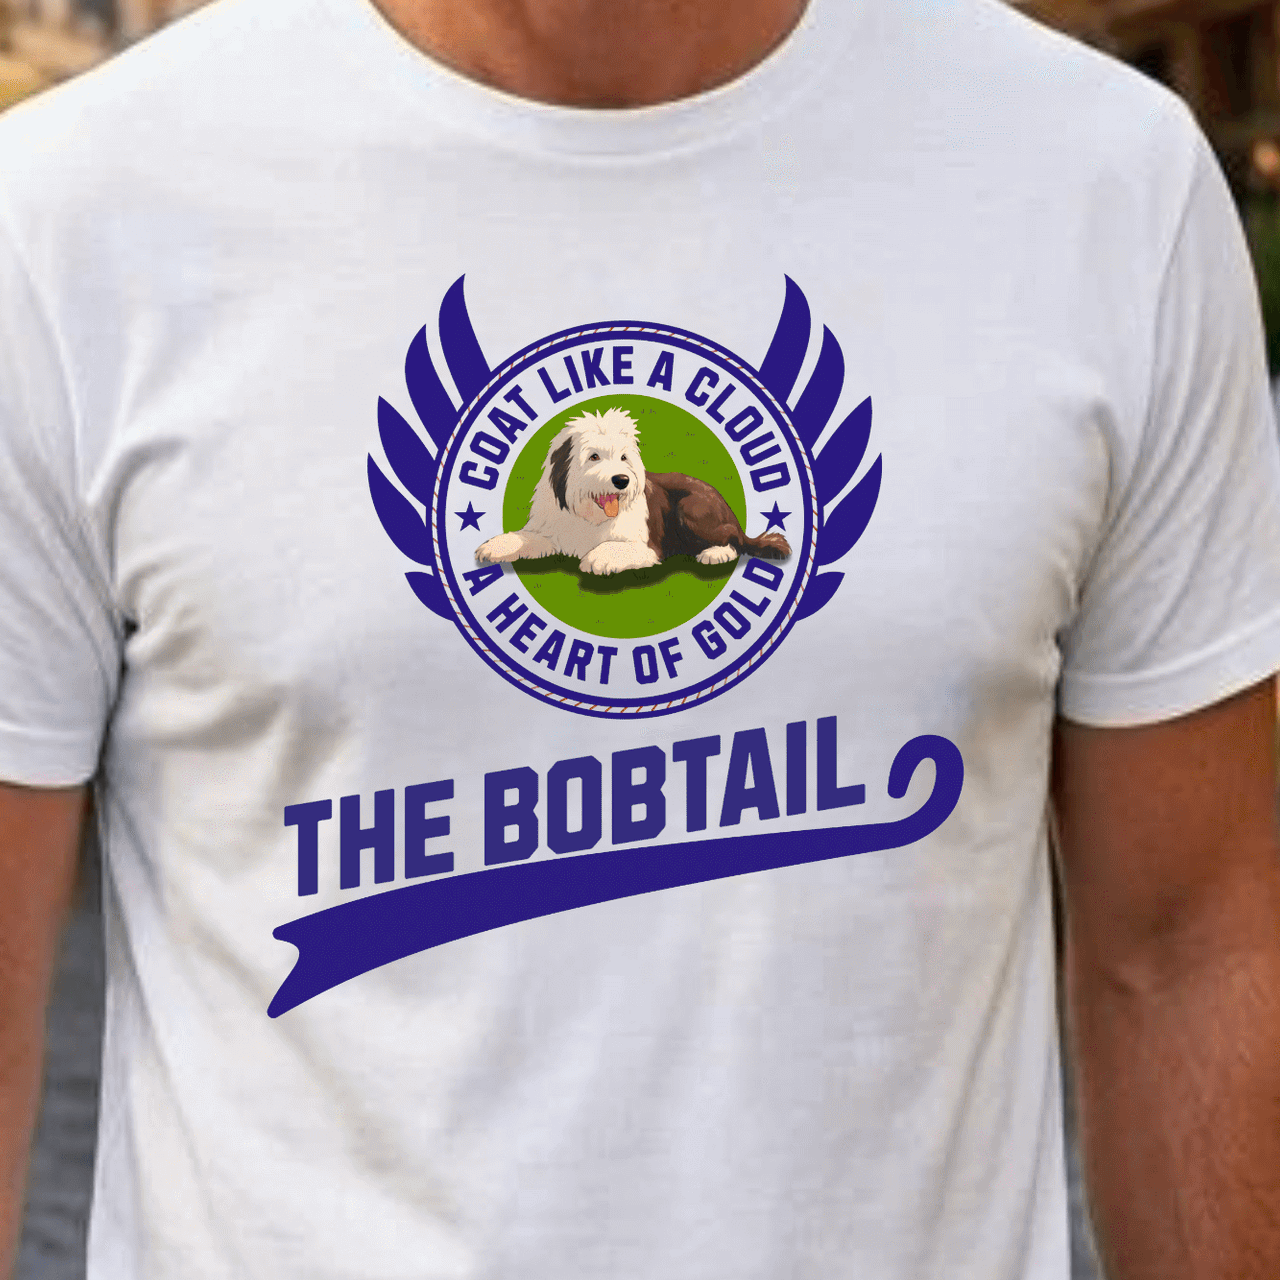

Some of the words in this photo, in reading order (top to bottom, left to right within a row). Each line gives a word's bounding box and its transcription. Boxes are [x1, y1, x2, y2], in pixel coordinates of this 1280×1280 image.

[458, 384, 539, 491] COAT
[536, 345, 634, 404] LIKE
[646, 350, 675, 392] A
[684, 366, 792, 493] CLOUD
[461, 563, 505, 597] A
[485, 592, 619, 685] HEART
[632, 636, 683, 685] OF
[691, 556, 785, 660] GOLD
[284, 778, 455, 897] THE
[484, 715, 866, 867] BOBTAIL
